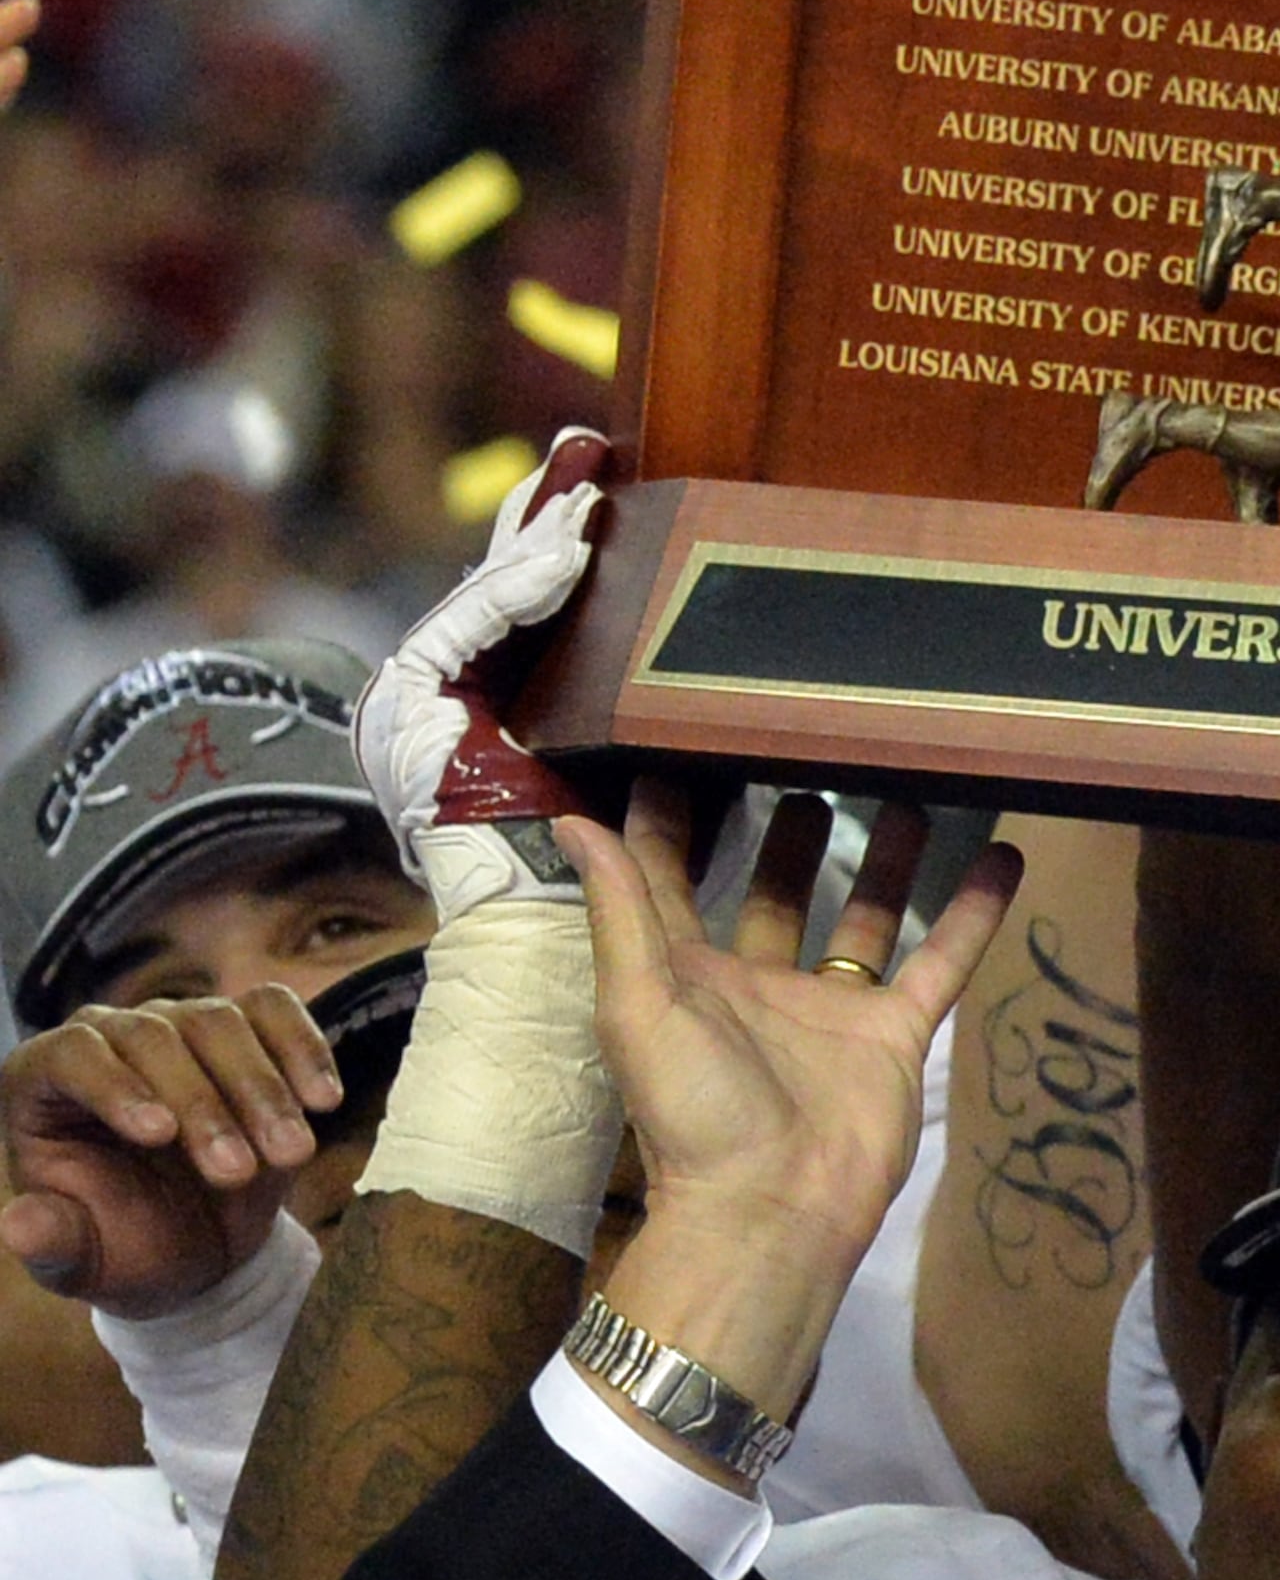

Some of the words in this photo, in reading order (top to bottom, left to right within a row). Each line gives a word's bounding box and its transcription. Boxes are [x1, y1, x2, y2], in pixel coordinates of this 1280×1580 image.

[1121, 10, 1168, 42] OF
[895, 44, 1097, 95] UNIVERSITY
[1105, 69, 1153, 99] OF
[938, 111, 1080, 154] AUBURN
[901, 166, 1103, 215] UNIVERSITY
[1112, 189, 1158, 220] OF
[893, 225, 1095, 274] UNIVERSITY
[1103, 249, 1151, 280] OF
[871, 283, 1073, 332] UNIVERSITY
[1081, 307, 1128, 338] OF
[838, 339, 1020, 387] LOUISIANA
[1029, 361, 1132, 397] STATE
